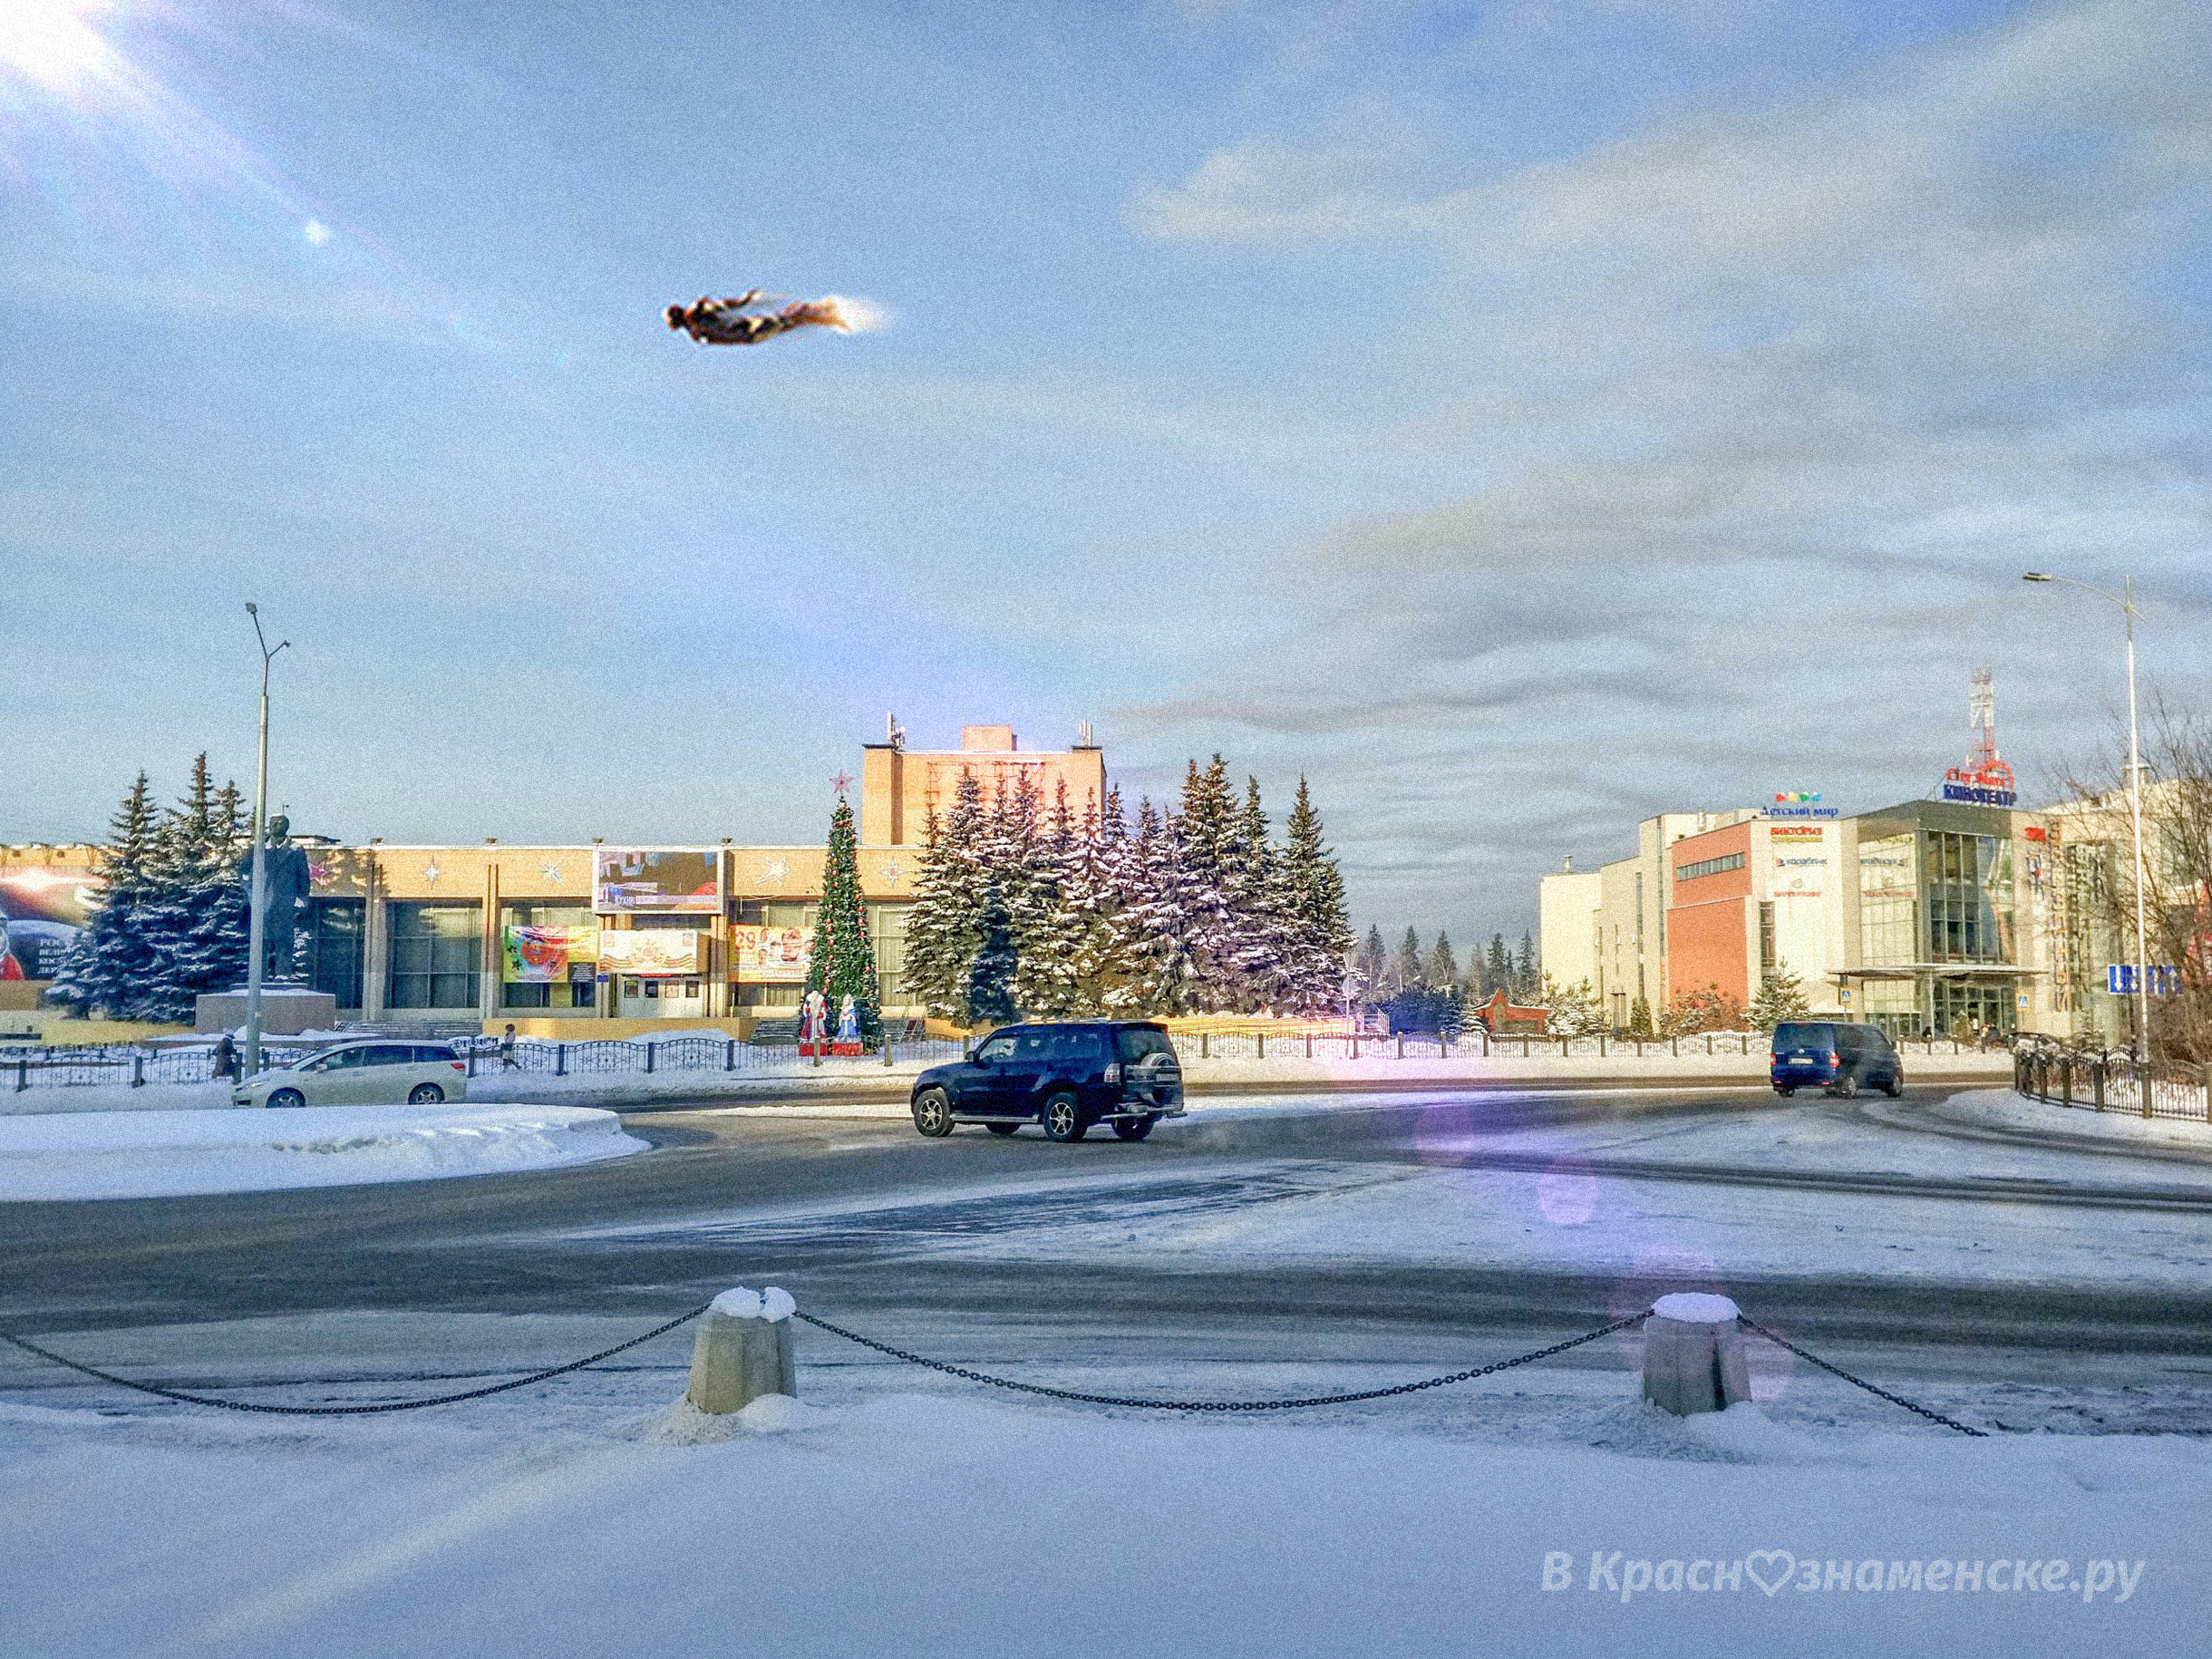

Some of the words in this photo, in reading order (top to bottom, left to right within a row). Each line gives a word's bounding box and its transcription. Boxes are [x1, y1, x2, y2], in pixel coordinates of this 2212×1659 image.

[1943, 783, 2017, 807] КИНОТЕАТР
[1760, 805, 1811, 817] Детский
[1813, 808, 1839, 818] мир
[735, 930, 756, 950] 29
